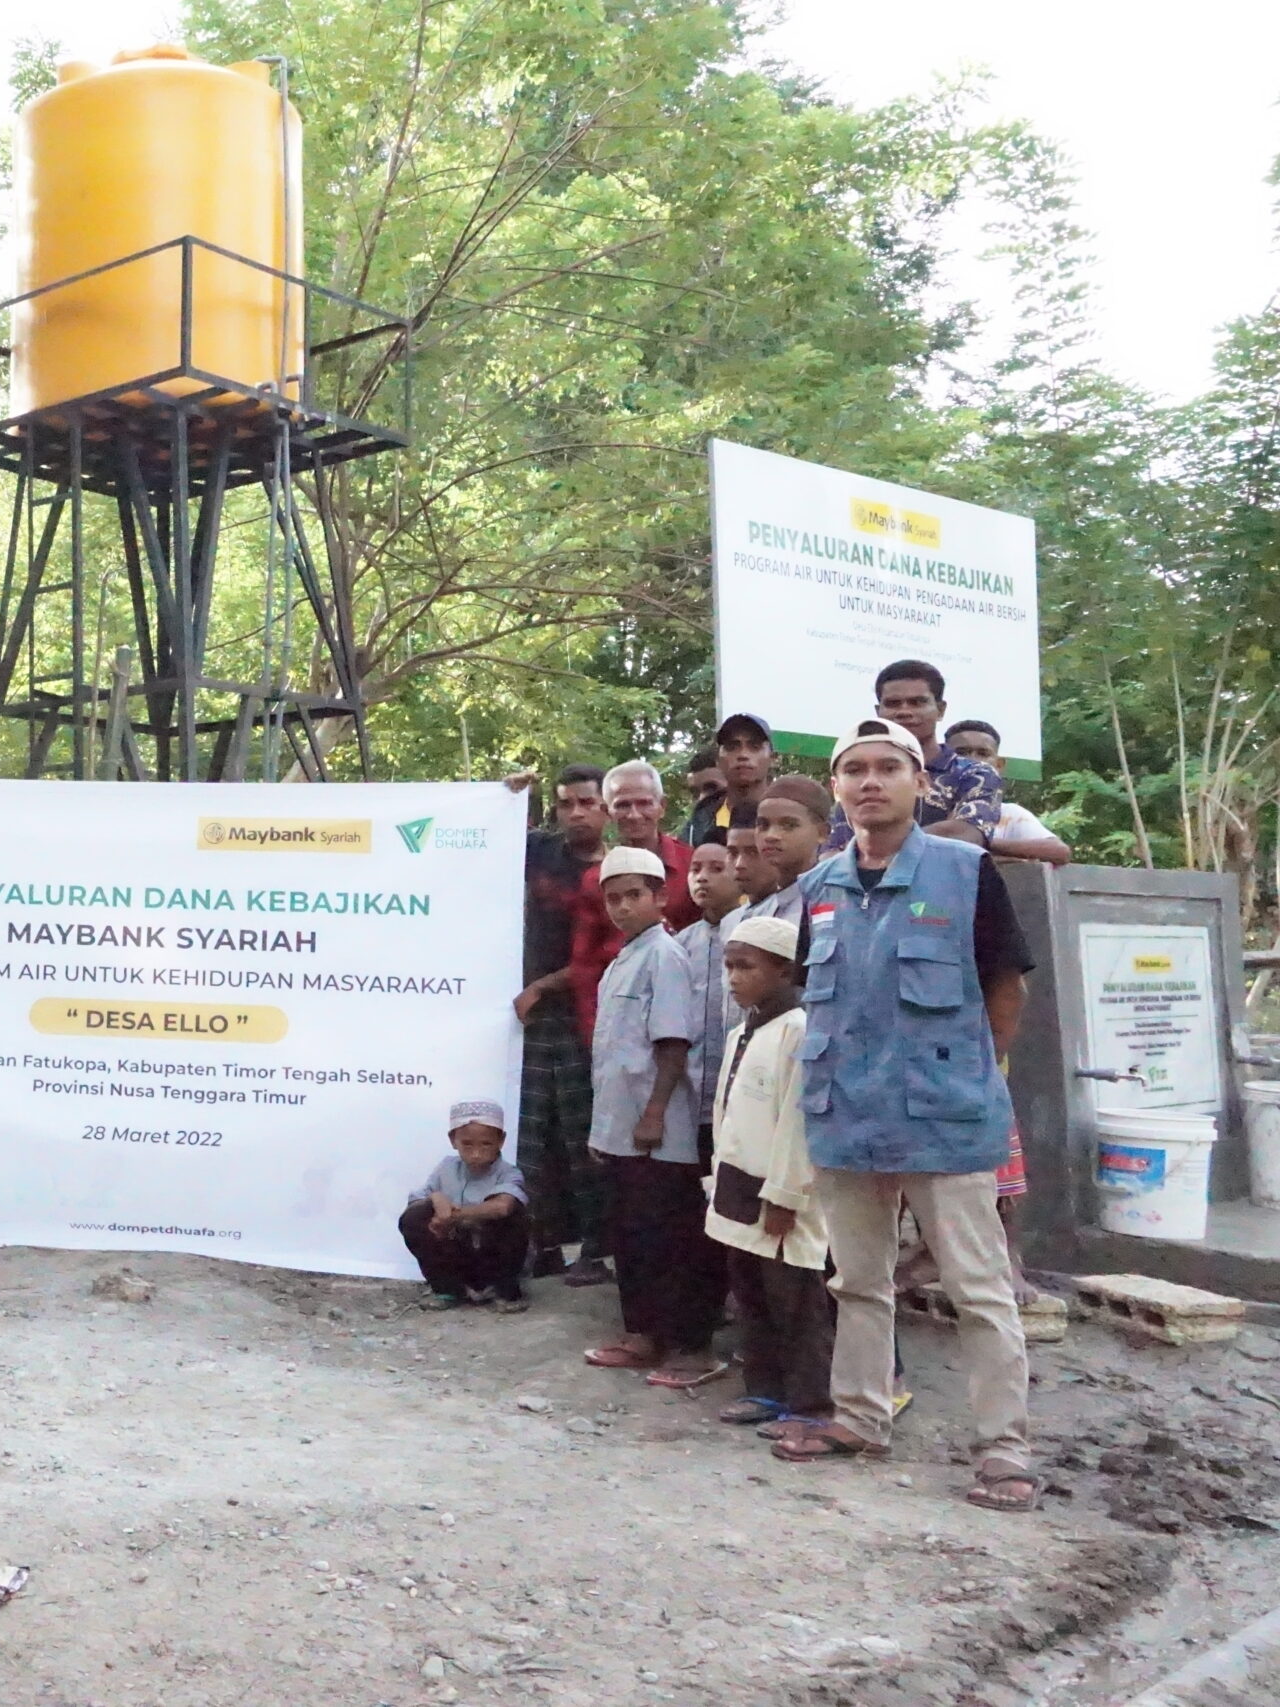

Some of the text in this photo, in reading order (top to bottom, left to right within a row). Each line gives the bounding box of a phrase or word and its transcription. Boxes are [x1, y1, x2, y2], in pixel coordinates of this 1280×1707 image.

[868, 511, 913, 534] Maybnk
[748, 520, 1014, 597] PENYALURAN DANA KEBAJIKAN
[734, 552, 1027, 622] PROGRAM AIR UNTUK KEHIDUPAN PENGADAAN AIR BERSIH
[839, 595, 942, 628] UNTUK MASYARAKAT
[228, 826, 361, 846] Maybank Syariah
[435, 827, 488, 839] DOMPET
[435, 838, 488, 850] DHUAFA
[144, 887, 235, 910] DANA
[246, 890, 431, 916] KEBAJIKAN
[7, 922, 317, 953] MAYBANK SYARIAH
[18, 963, 57, 981] AIR
[65, 965, 145, 984] UNTUK
[152, 968, 293, 990] KEHIDUPAN
[302, 973, 467, 995] MASYARAKAT
[86, 1010, 155, 1031] DESA
[164, 1013, 228, 1034] ELLO
[23, 1055, 111, 1074] Fatukopa,
[117, 1059, 216, 1078] Kabupaten
[222, 1063, 276, 1079] Timor
[282, 1066, 350, 1085] Tengah
[357, 1069, 433, 1087] Selatan,
[32, 1079, 307, 1105] Provinsi Nusa Tenggara Timur
[82, 1125, 222, 1147] 28 Maret 2022
[69, 1222, 242, 1240] www.dompetdhuafa.org
